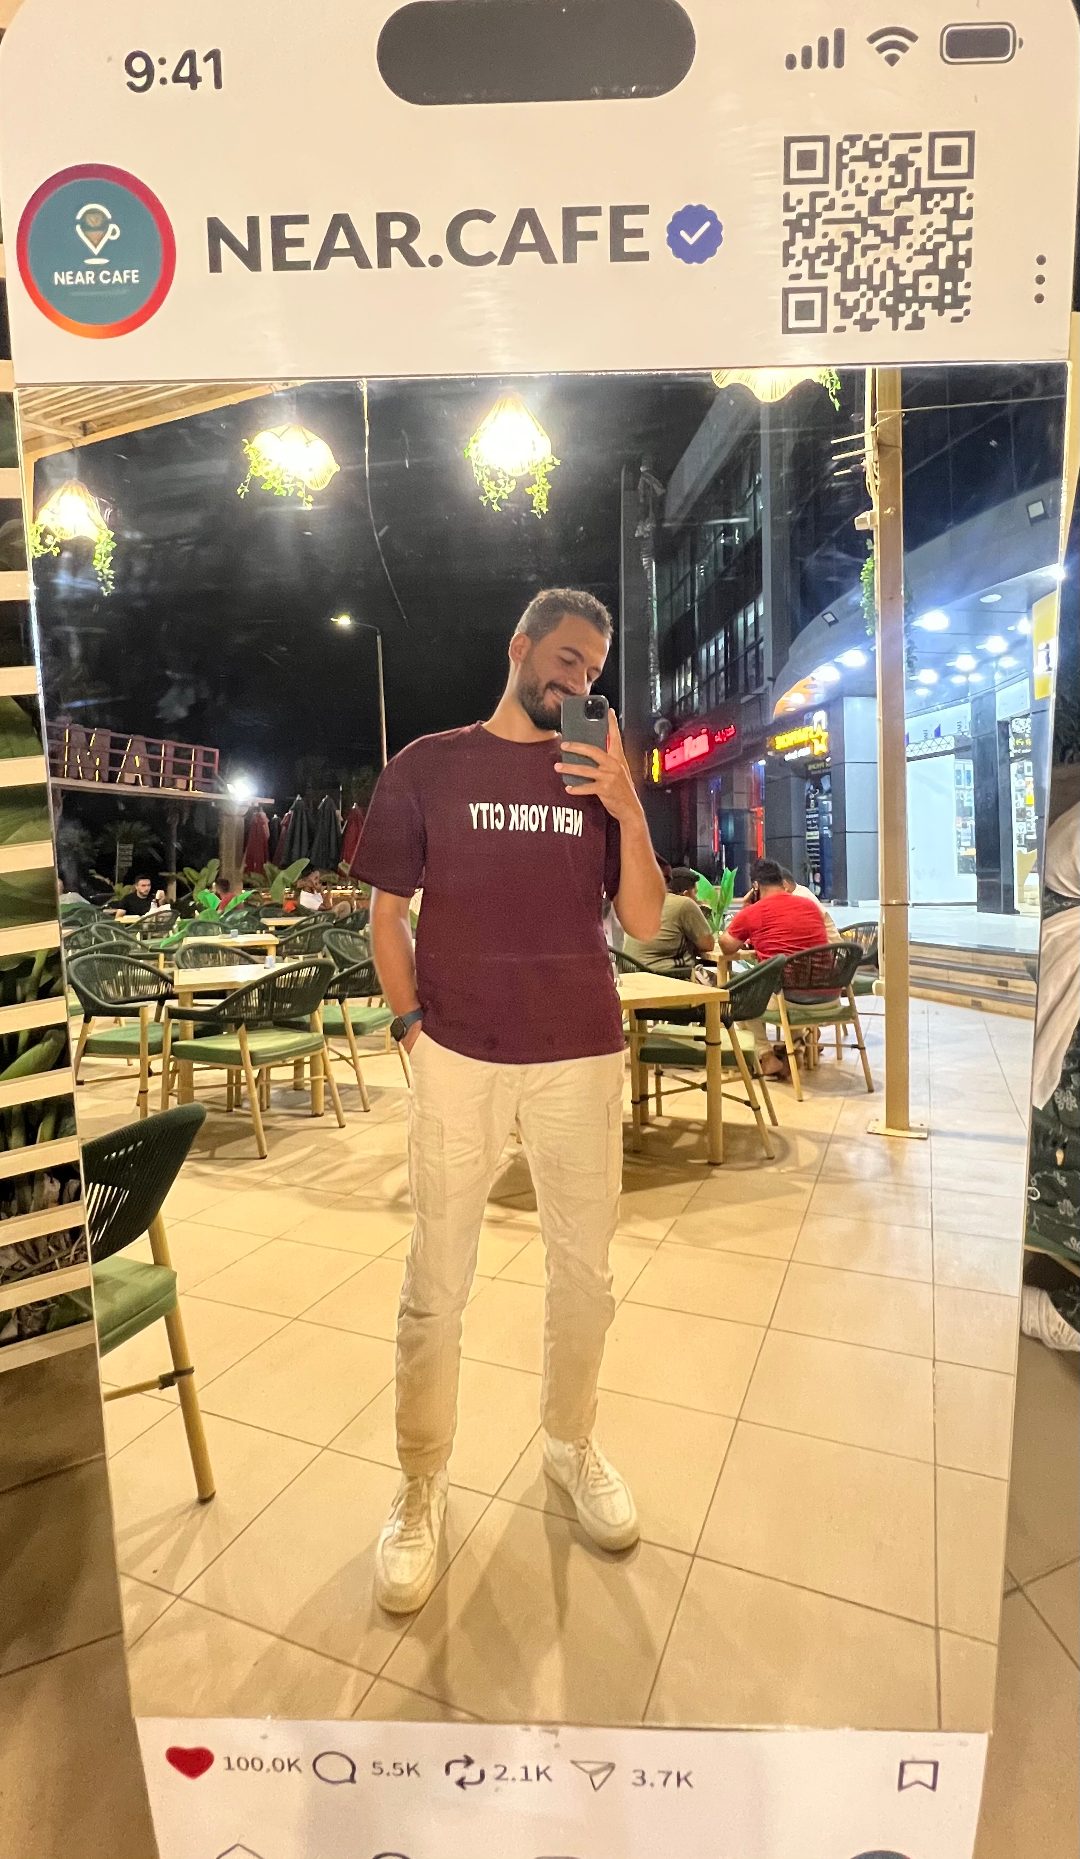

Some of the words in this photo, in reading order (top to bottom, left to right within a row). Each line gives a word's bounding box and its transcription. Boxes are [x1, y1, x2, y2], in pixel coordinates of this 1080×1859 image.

[125, 49, 223, 92] 9:41
[207, 204, 650, 273] NEAR.CAFE
[54, 271, 96, 286] NEAR
[99, 270, 140, 284] CAFE
[371, 1761, 421, 1778] 5.5K
[494, 1764, 553, 1783] 2.1K
[632, 1769, 694, 1789] 3.7K
